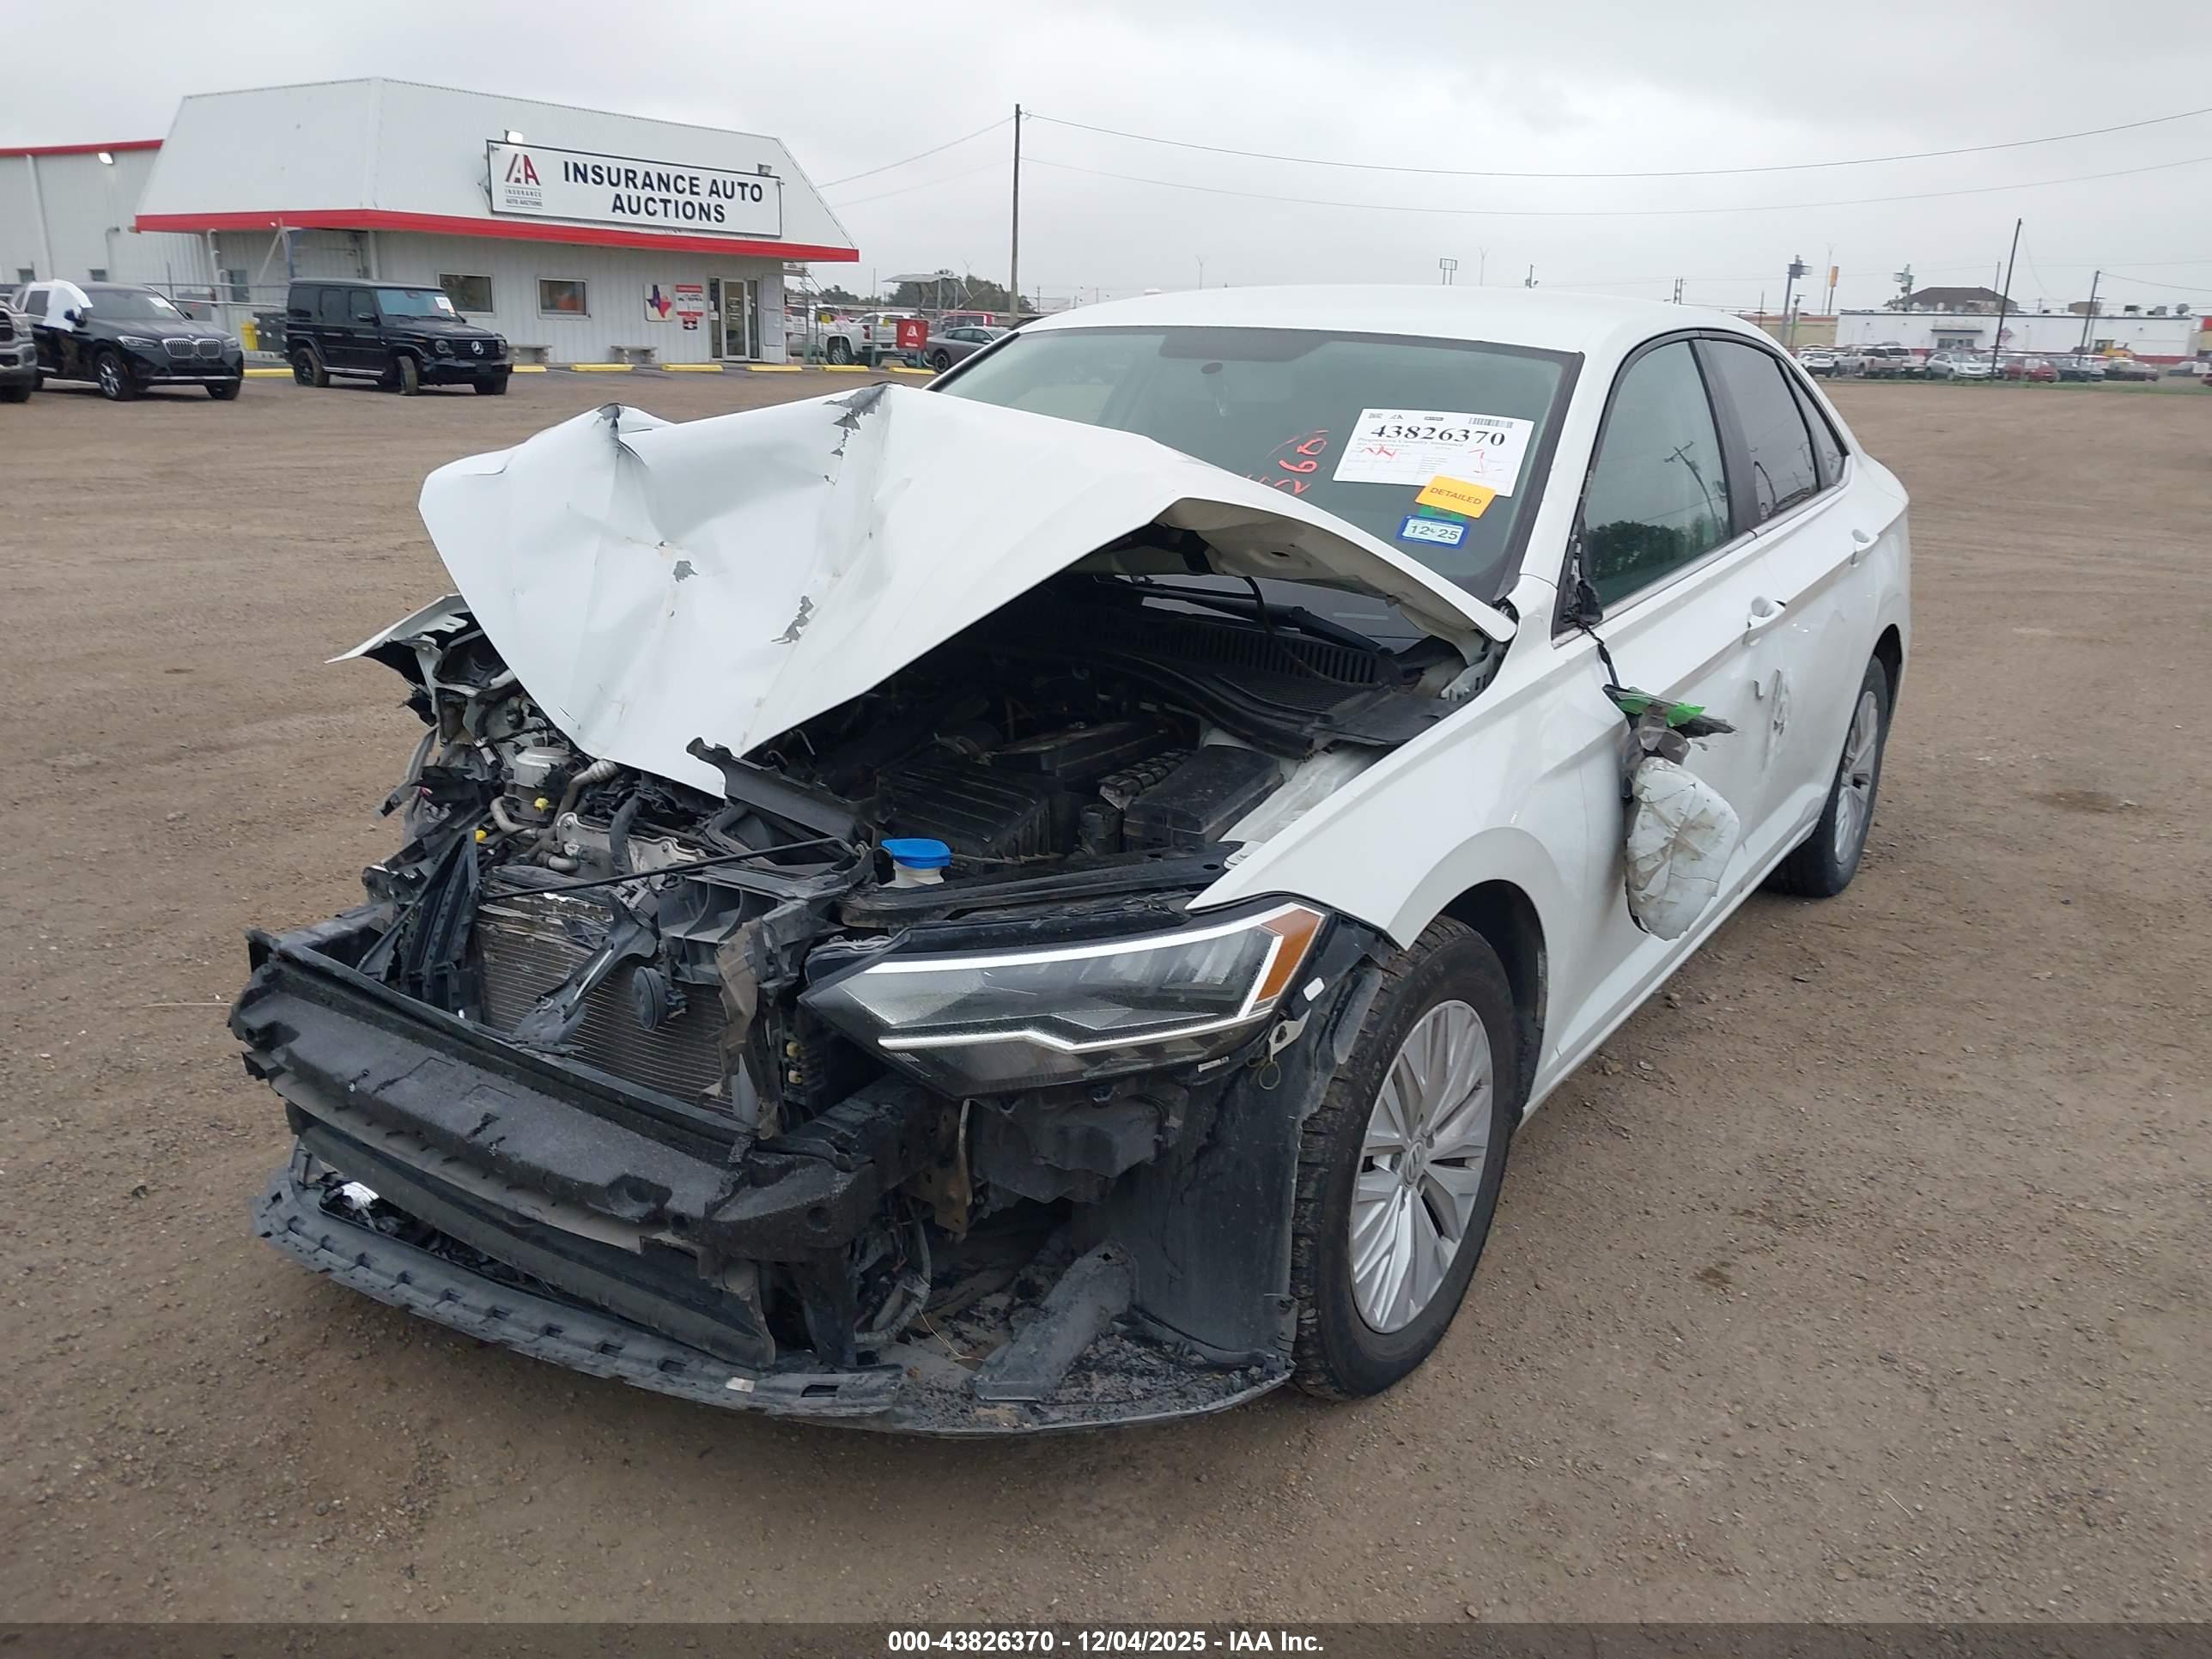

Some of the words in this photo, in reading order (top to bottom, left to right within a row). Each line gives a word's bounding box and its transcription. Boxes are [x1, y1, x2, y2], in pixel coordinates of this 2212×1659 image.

[563, 161, 702, 197] INSURANCE
[708, 179, 763, 203] AUTO
[611, 193, 726, 224] AUCTIONS
[1370, 424, 1506, 447] 43826370
[1430, 487, 1483, 506] DETAILED
[1411, 525, 1431, 536] 12
[1437, 528, 1459, 541] 25
